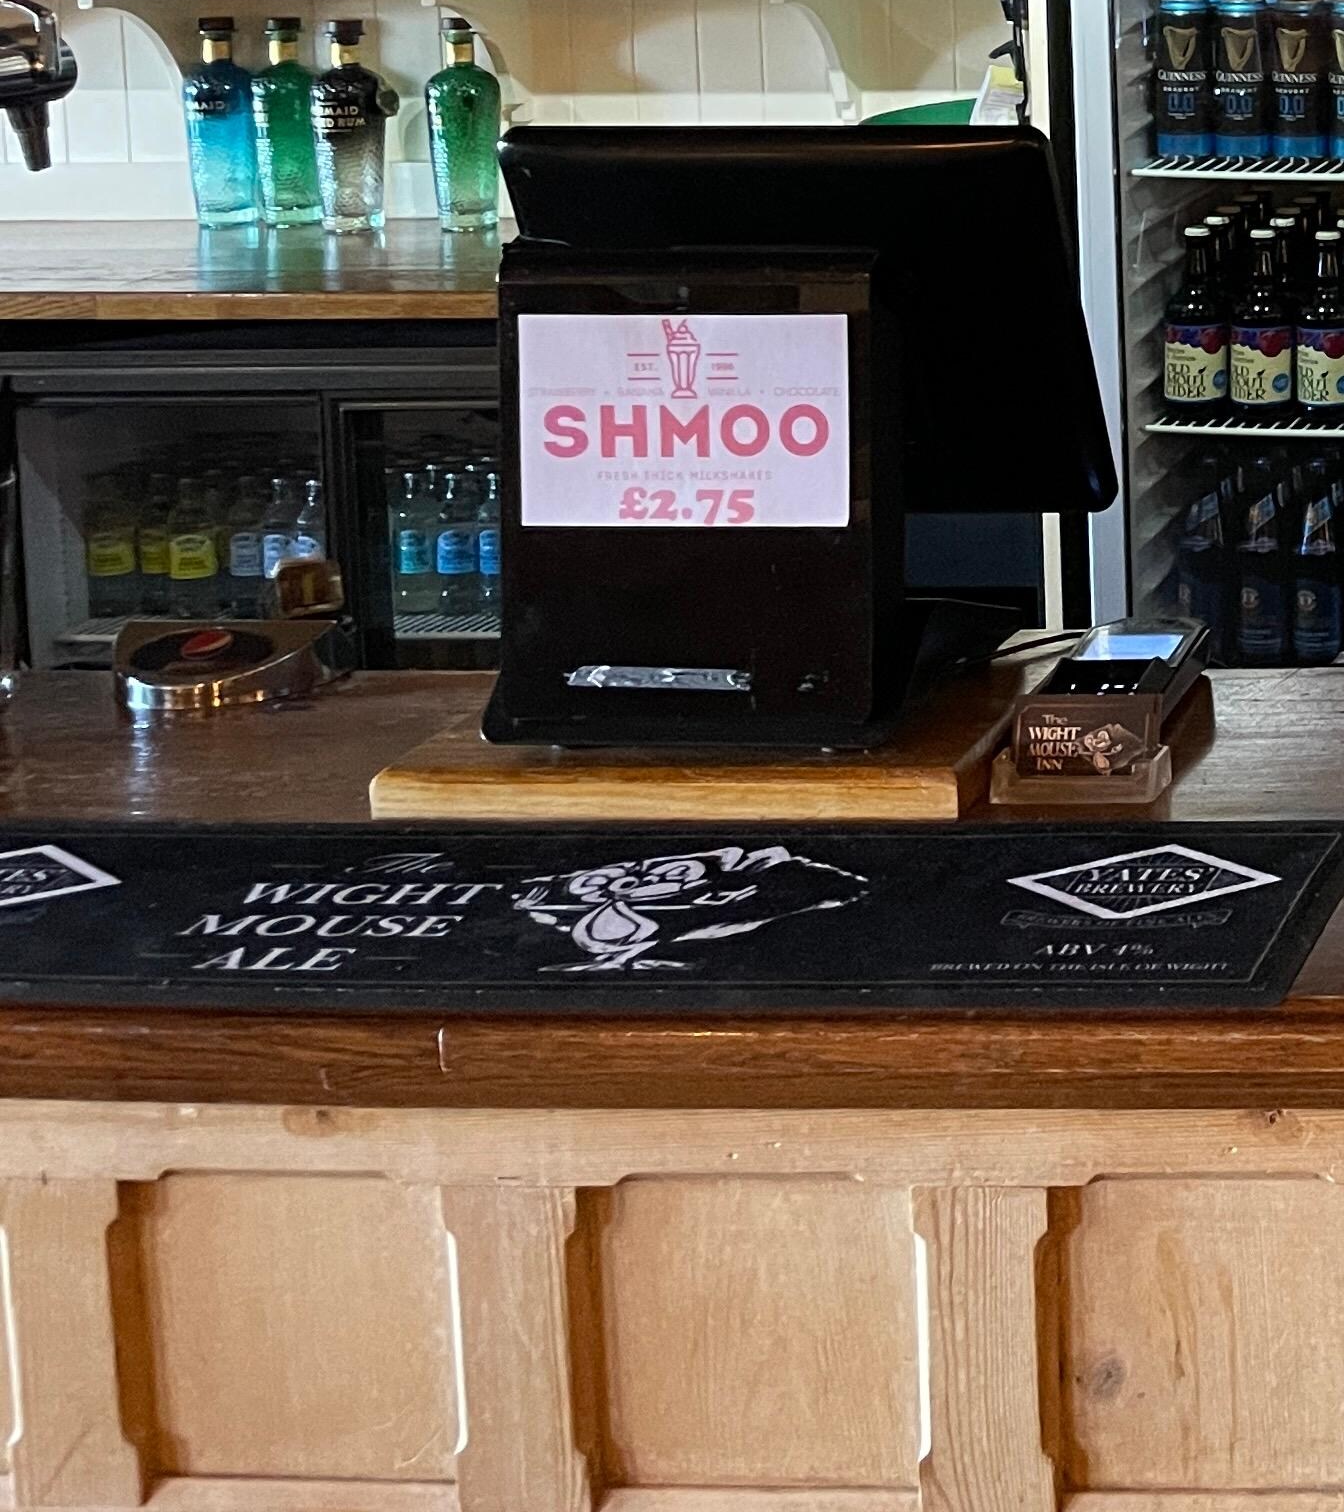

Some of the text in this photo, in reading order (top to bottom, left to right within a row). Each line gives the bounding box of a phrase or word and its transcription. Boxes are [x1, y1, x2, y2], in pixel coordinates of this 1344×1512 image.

[1158, 69, 1207, 82] GUINNESS
[1215, 70, 1264, 83] GUINNESS
[1272, 71, 1318, 84] GUINNESS
[543, 403, 829, 459] SHMOO
[618, 487, 755, 526] £2.75
[1041, 714, 1068, 725] The
[1028, 726, 1081, 741] WIGHT
[1029, 742, 1079, 757] MOUSE
[1036, 759, 1066, 770] INN
[240, 881, 503, 906] WIGHT
[1075, 883, 1204, 894] BREWERY
[176, 913, 465, 937] MOUSE
[1034, 944, 1106, 956] ABV
[191, 946, 357, 972] ALE
